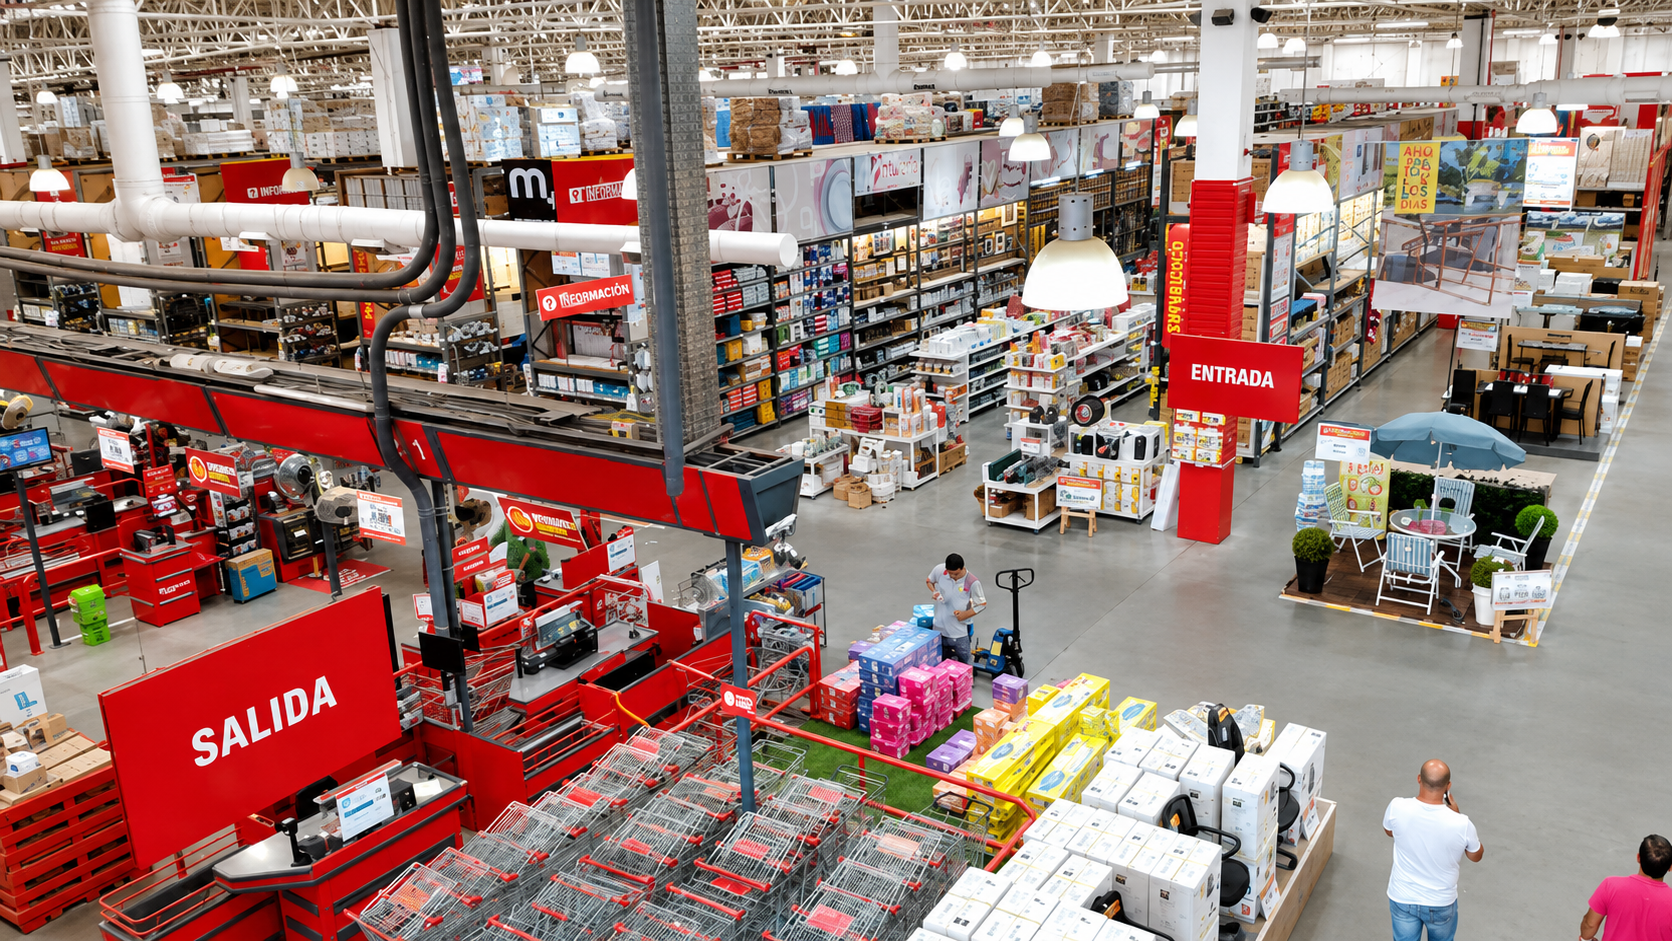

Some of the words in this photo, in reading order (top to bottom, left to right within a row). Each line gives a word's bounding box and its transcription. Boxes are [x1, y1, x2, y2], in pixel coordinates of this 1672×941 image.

[559, 283, 630, 308] INFORMACIÓN
[1191, 363, 1275, 389] ENTRADA
[412, 439, 426, 460] 1
[192, 676, 337, 766] SALIDA
